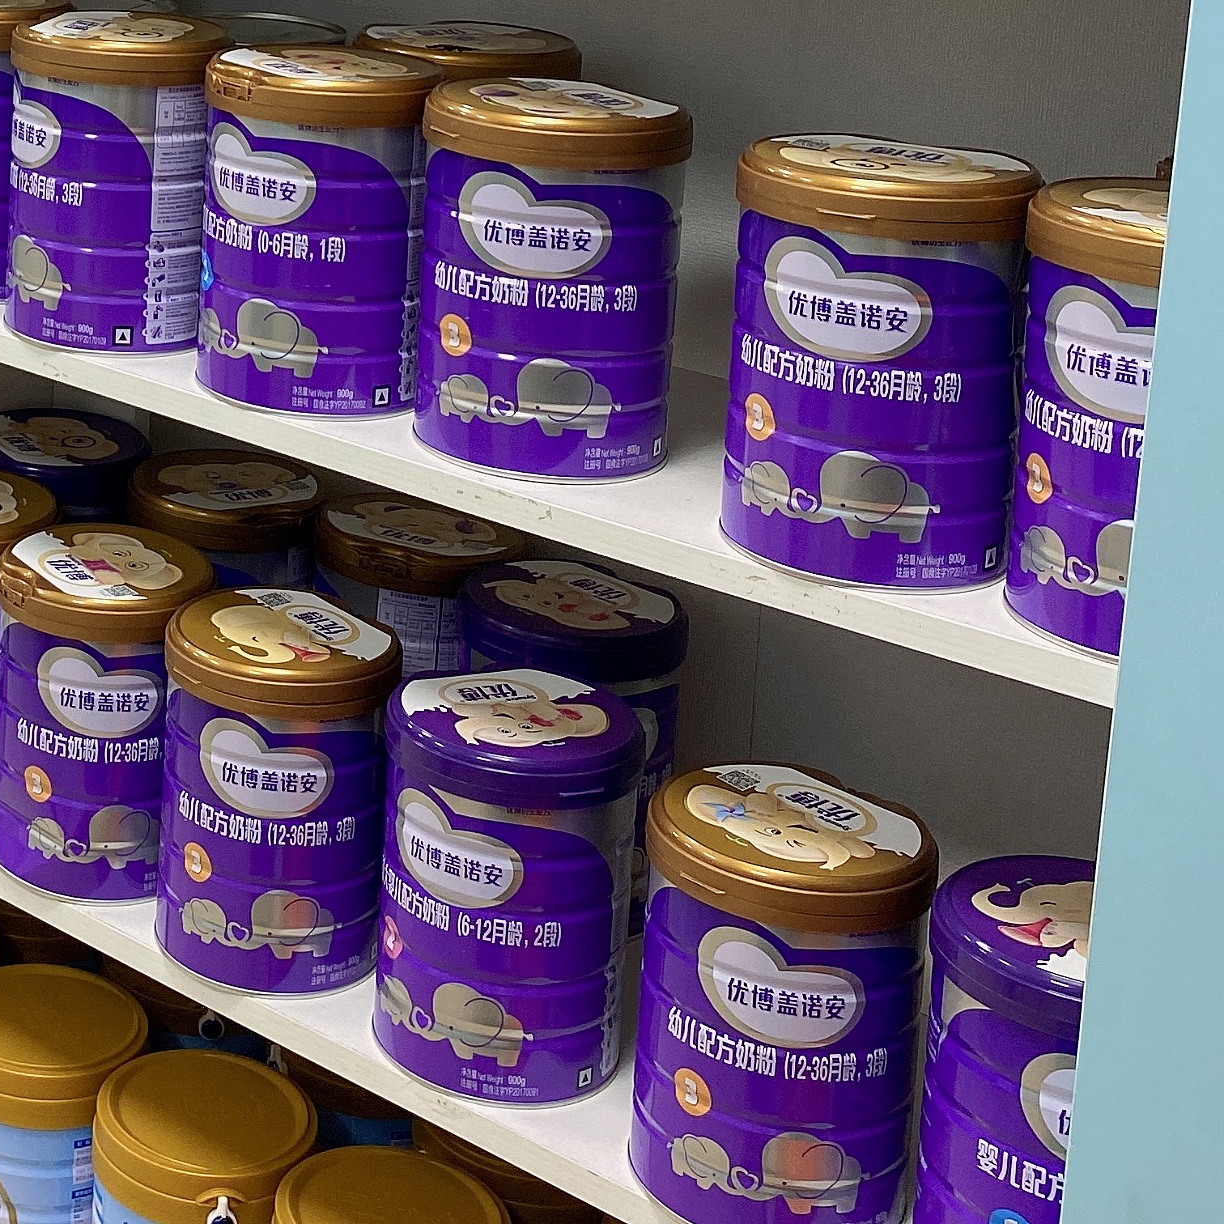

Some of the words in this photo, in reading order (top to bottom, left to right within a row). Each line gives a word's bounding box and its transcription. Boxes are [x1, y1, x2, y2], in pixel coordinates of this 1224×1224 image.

[218, 165, 298, 204] 优博盖诺安
[483, 218, 592, 253] 优博盖诺安
[434, 260, 529, 307] 幼儿配方奶粉
[787, 290, 909, 334] 优博盖诺安
[741, 334, 834, 392] 幼儿配方奶粉
[1025, 388, 1114, 455] 幼儿配方奶粉
[59, 686, 150, 714] 优博盖诺安
[17, 716, 99, 764] 幼儿配方奶粉
[221, 760, 319, 795] 优博盖诺安
[179, 789, 262, 846] 幼儿配方奶粉
[786, 789, 863, 824] 优博
[409, 834, 504, 888] 优博盖诺安
[726, 976, 846, 1021] 优博盖诺安
[667, 1005, 776, 1078] 幼儿配方奶粉
[683, 1077, 698, 1105] 3
